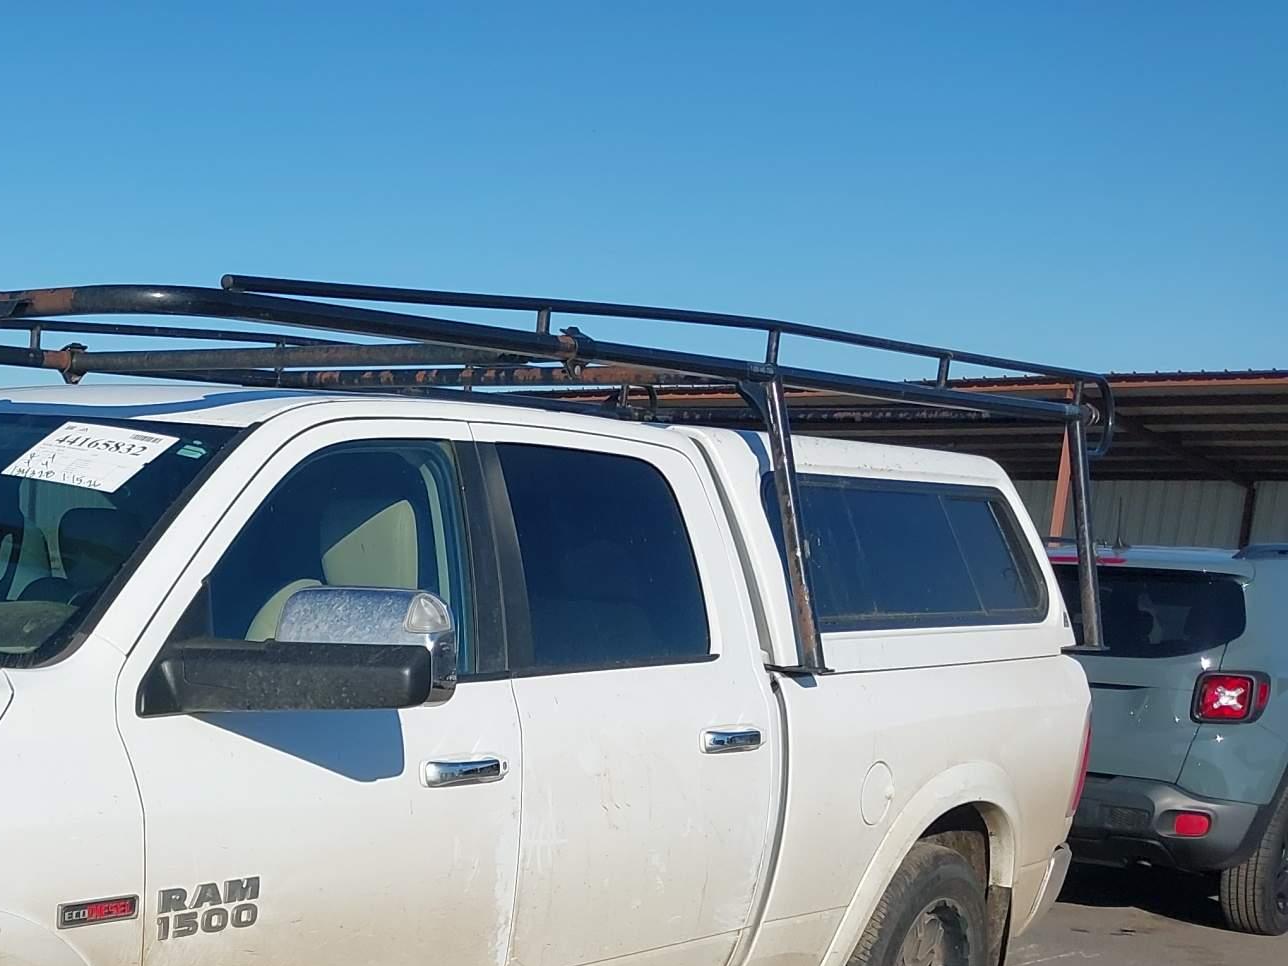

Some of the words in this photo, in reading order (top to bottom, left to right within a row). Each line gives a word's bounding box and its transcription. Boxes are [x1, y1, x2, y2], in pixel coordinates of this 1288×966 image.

[55, 434, 147, 457] 44165832
[158, 877, 260, 914] RAM
[156, 904, 259, 941] 1500
